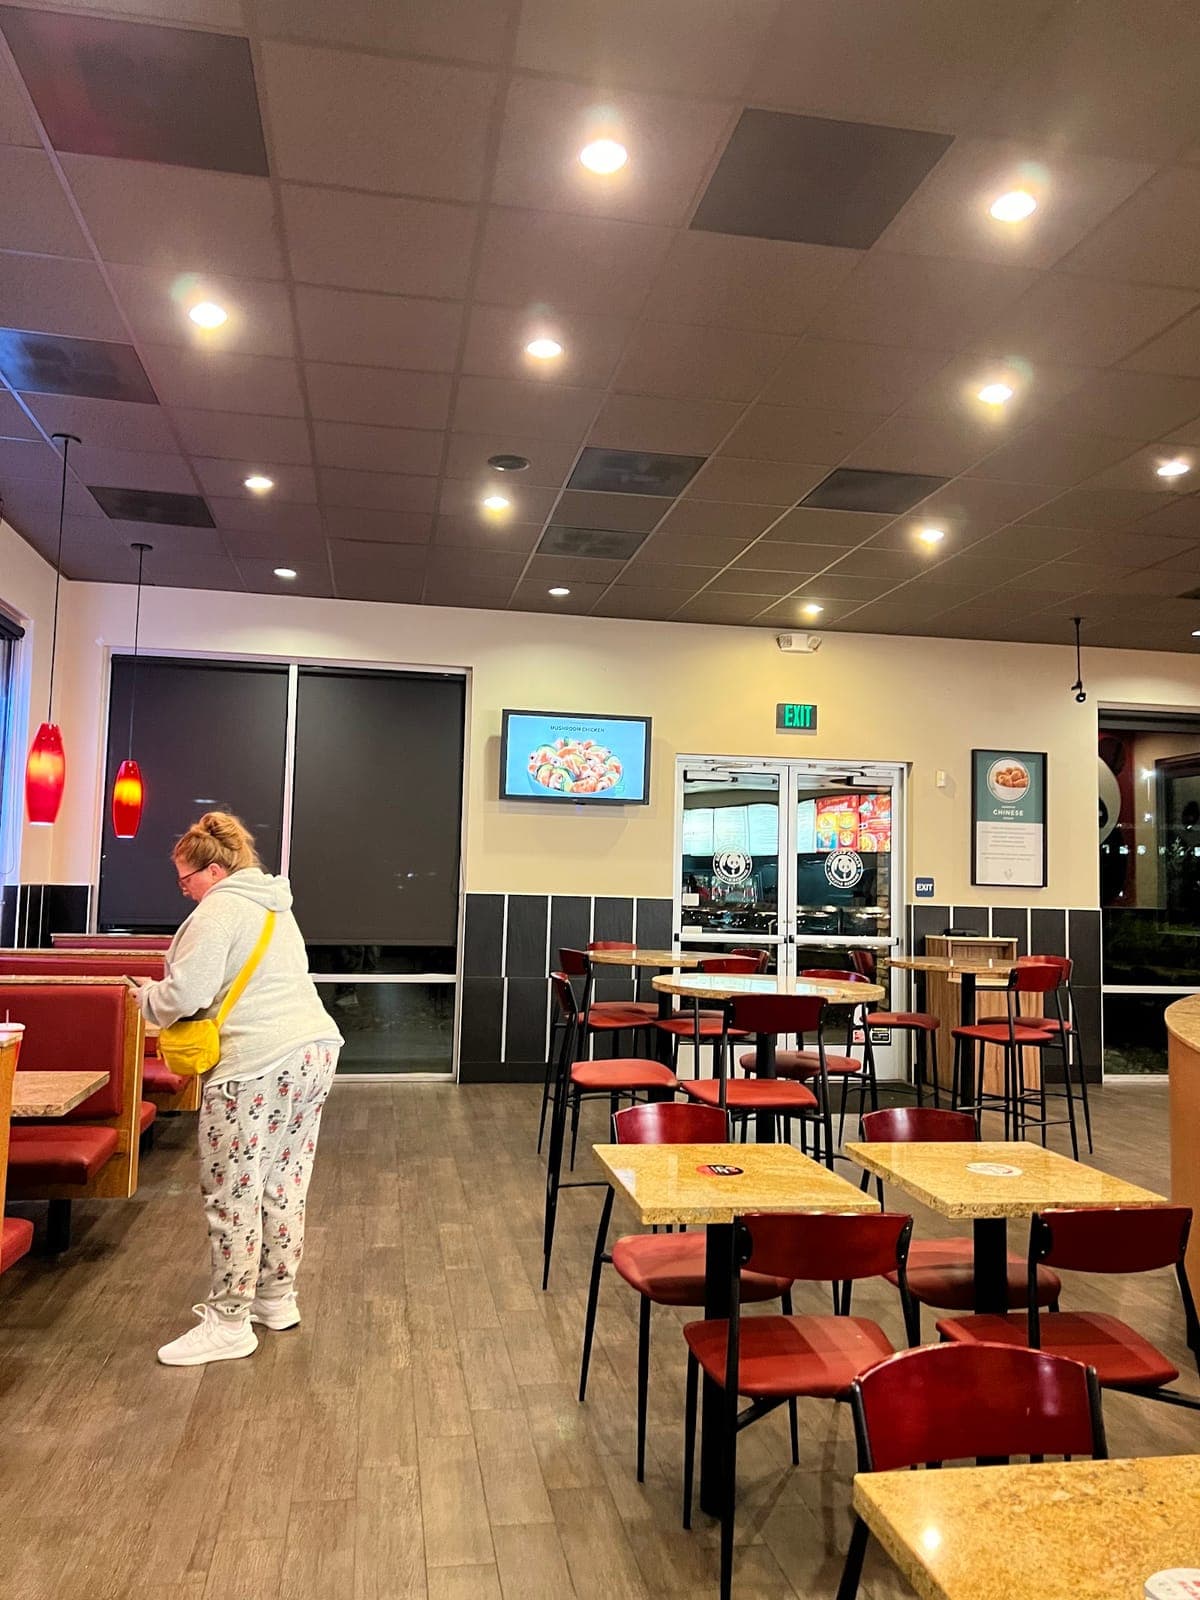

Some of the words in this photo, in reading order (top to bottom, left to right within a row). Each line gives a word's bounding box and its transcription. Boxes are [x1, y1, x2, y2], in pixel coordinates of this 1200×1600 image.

[784, 704, 813, 728] EXIT
[992, 808, 1024, 817] CHINESE
[916, 883, 933, 892] EXIT
